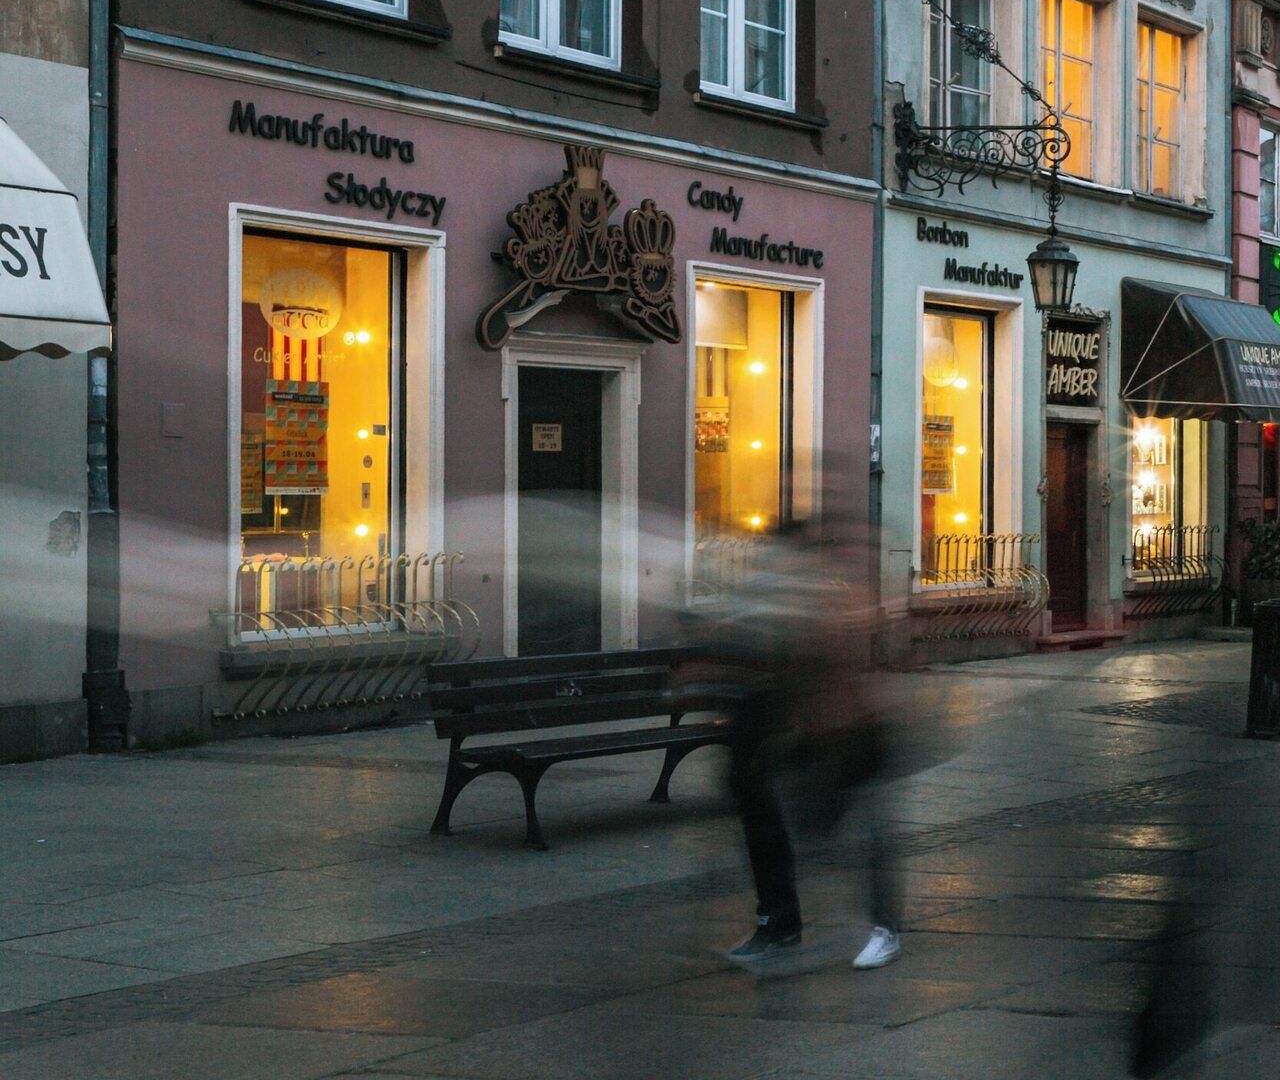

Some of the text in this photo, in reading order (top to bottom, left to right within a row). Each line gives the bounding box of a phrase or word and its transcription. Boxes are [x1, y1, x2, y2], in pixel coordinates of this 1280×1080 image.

[229, 99, 415, 163] Manufaktura
[324, 171, 446, 226] Słodyczy
[687, 180, 744, 221] Candy
[710, 226, 825, 269] Manufacture
[917, 216, 969, 248] Bonbon
[0, 223, 51, 280] SY
[944, 257, 1024, 290] Manufaktur
[1048, 329, 1100, 363] UNIQUE
[1240, 344, 1270, 365] UNIQUE
[1047, 363, 1098, 398] AMBER
